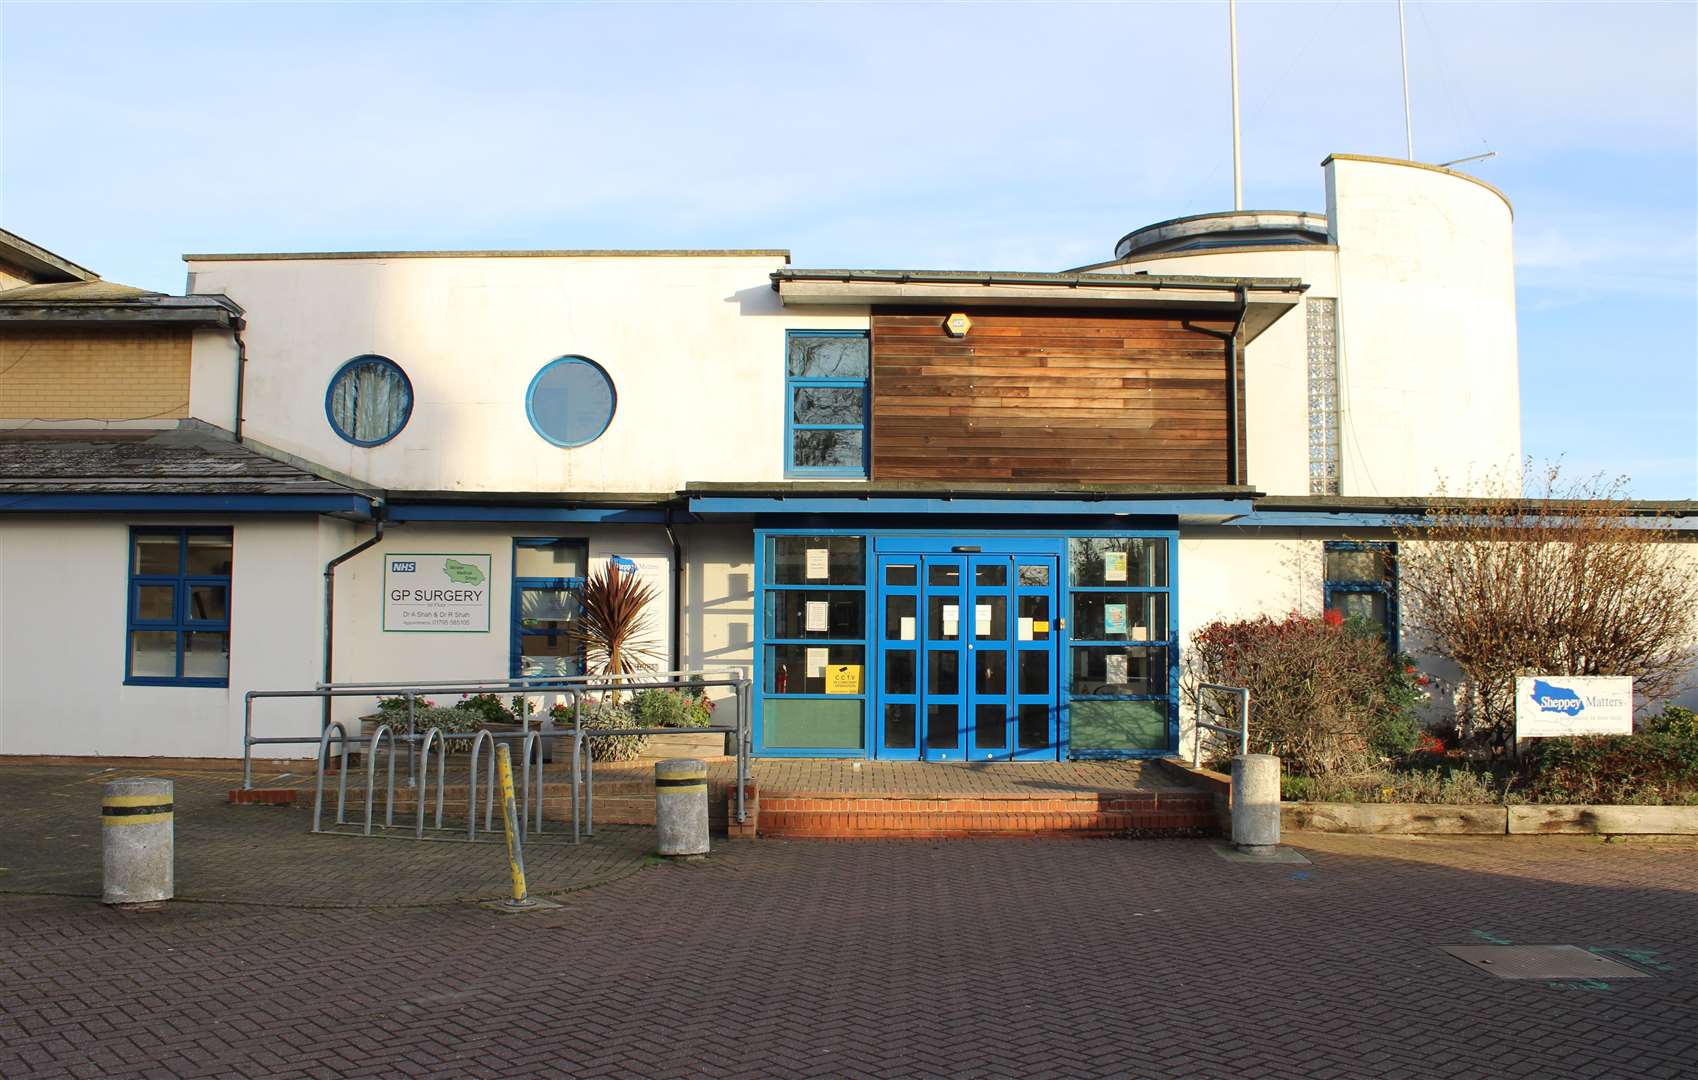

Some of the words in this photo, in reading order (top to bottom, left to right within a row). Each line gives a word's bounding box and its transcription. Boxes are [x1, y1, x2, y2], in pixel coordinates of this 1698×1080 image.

[393, 562, 415, 572] NHS
[391, 590, 411, 602] GP
[414, 590, 483, 602] SURGERY
[1541, 696, 1581, 710] Sheppey
[1586, 696, 1623, 707] Matters
